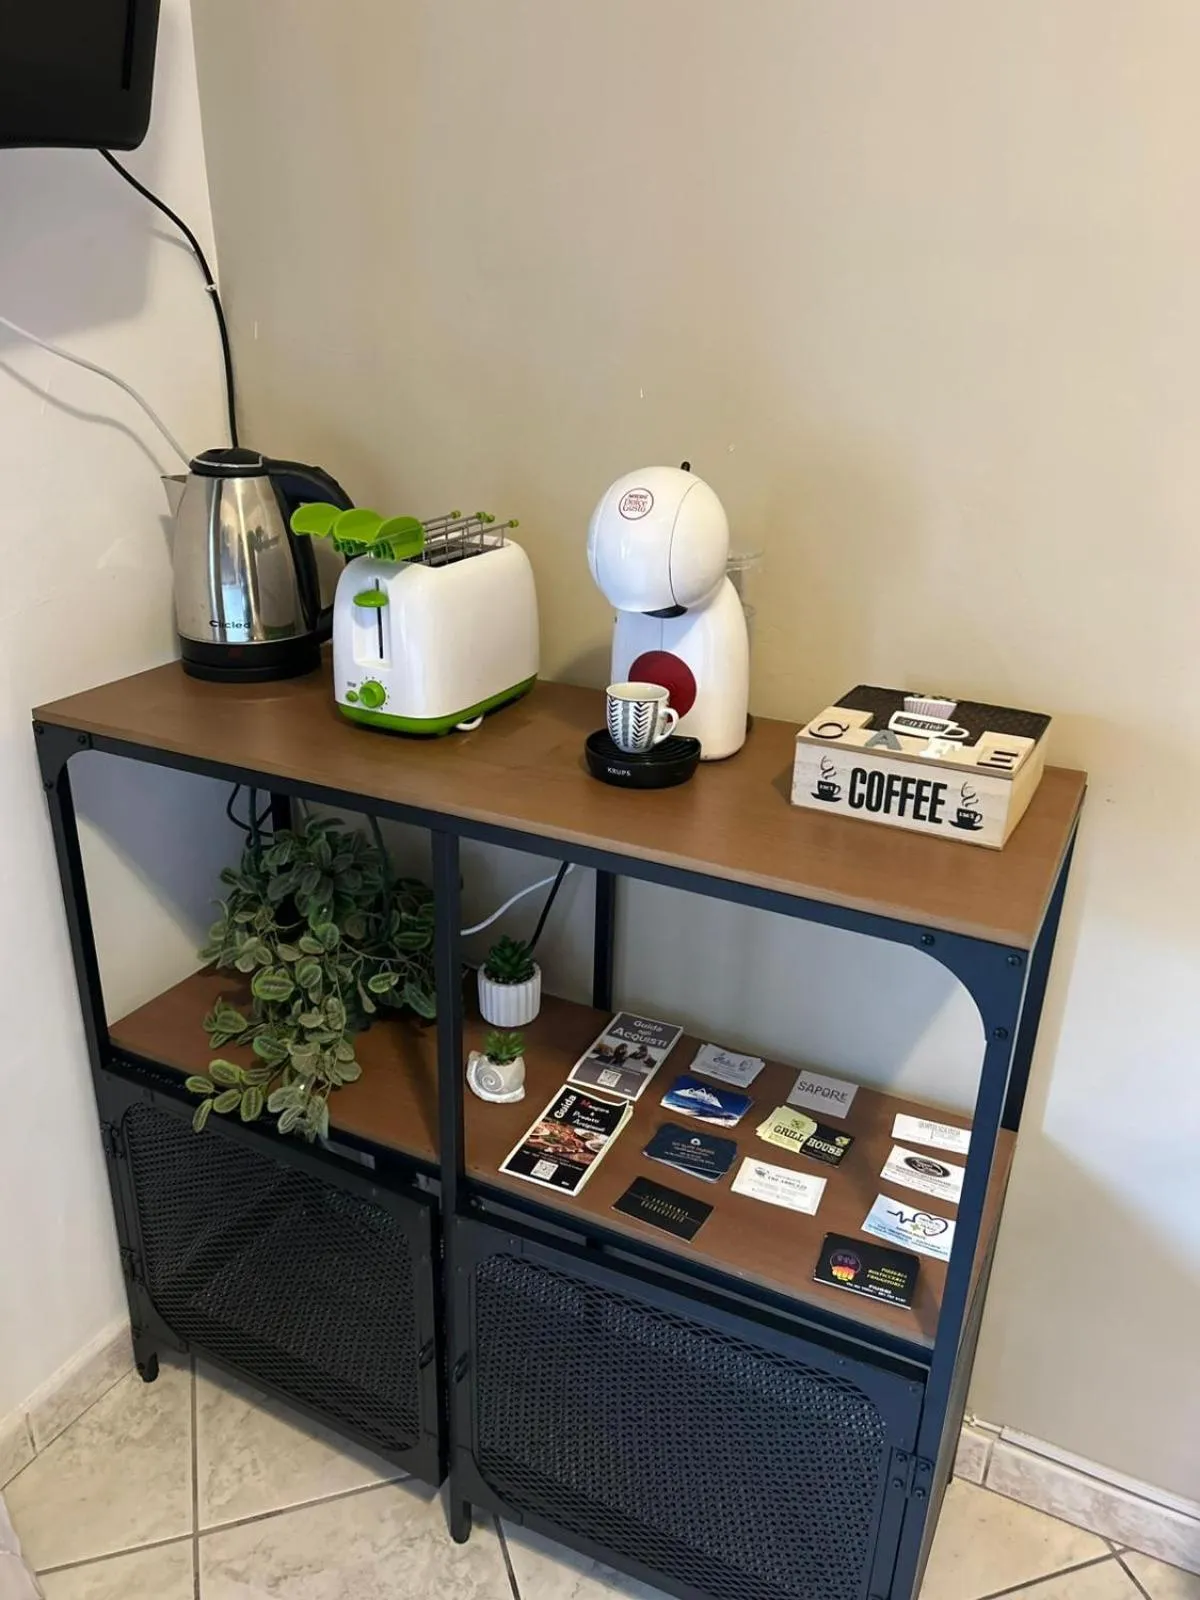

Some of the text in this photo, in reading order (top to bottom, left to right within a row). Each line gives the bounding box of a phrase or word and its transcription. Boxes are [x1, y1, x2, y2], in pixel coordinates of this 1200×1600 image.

[607, 766, 631, 776] KRUPS
[848, 767, 948, 824] COFFEE
[611, 1027, 668, 1047] ACQUISTI
[633, 1020, 663, 1032] Guida
[797, 1081, 849, 1104] SAPORE
[553, 1095, 577, 1119] Guida
[773, 1124, 844, 1157] GRILL HOUSE
